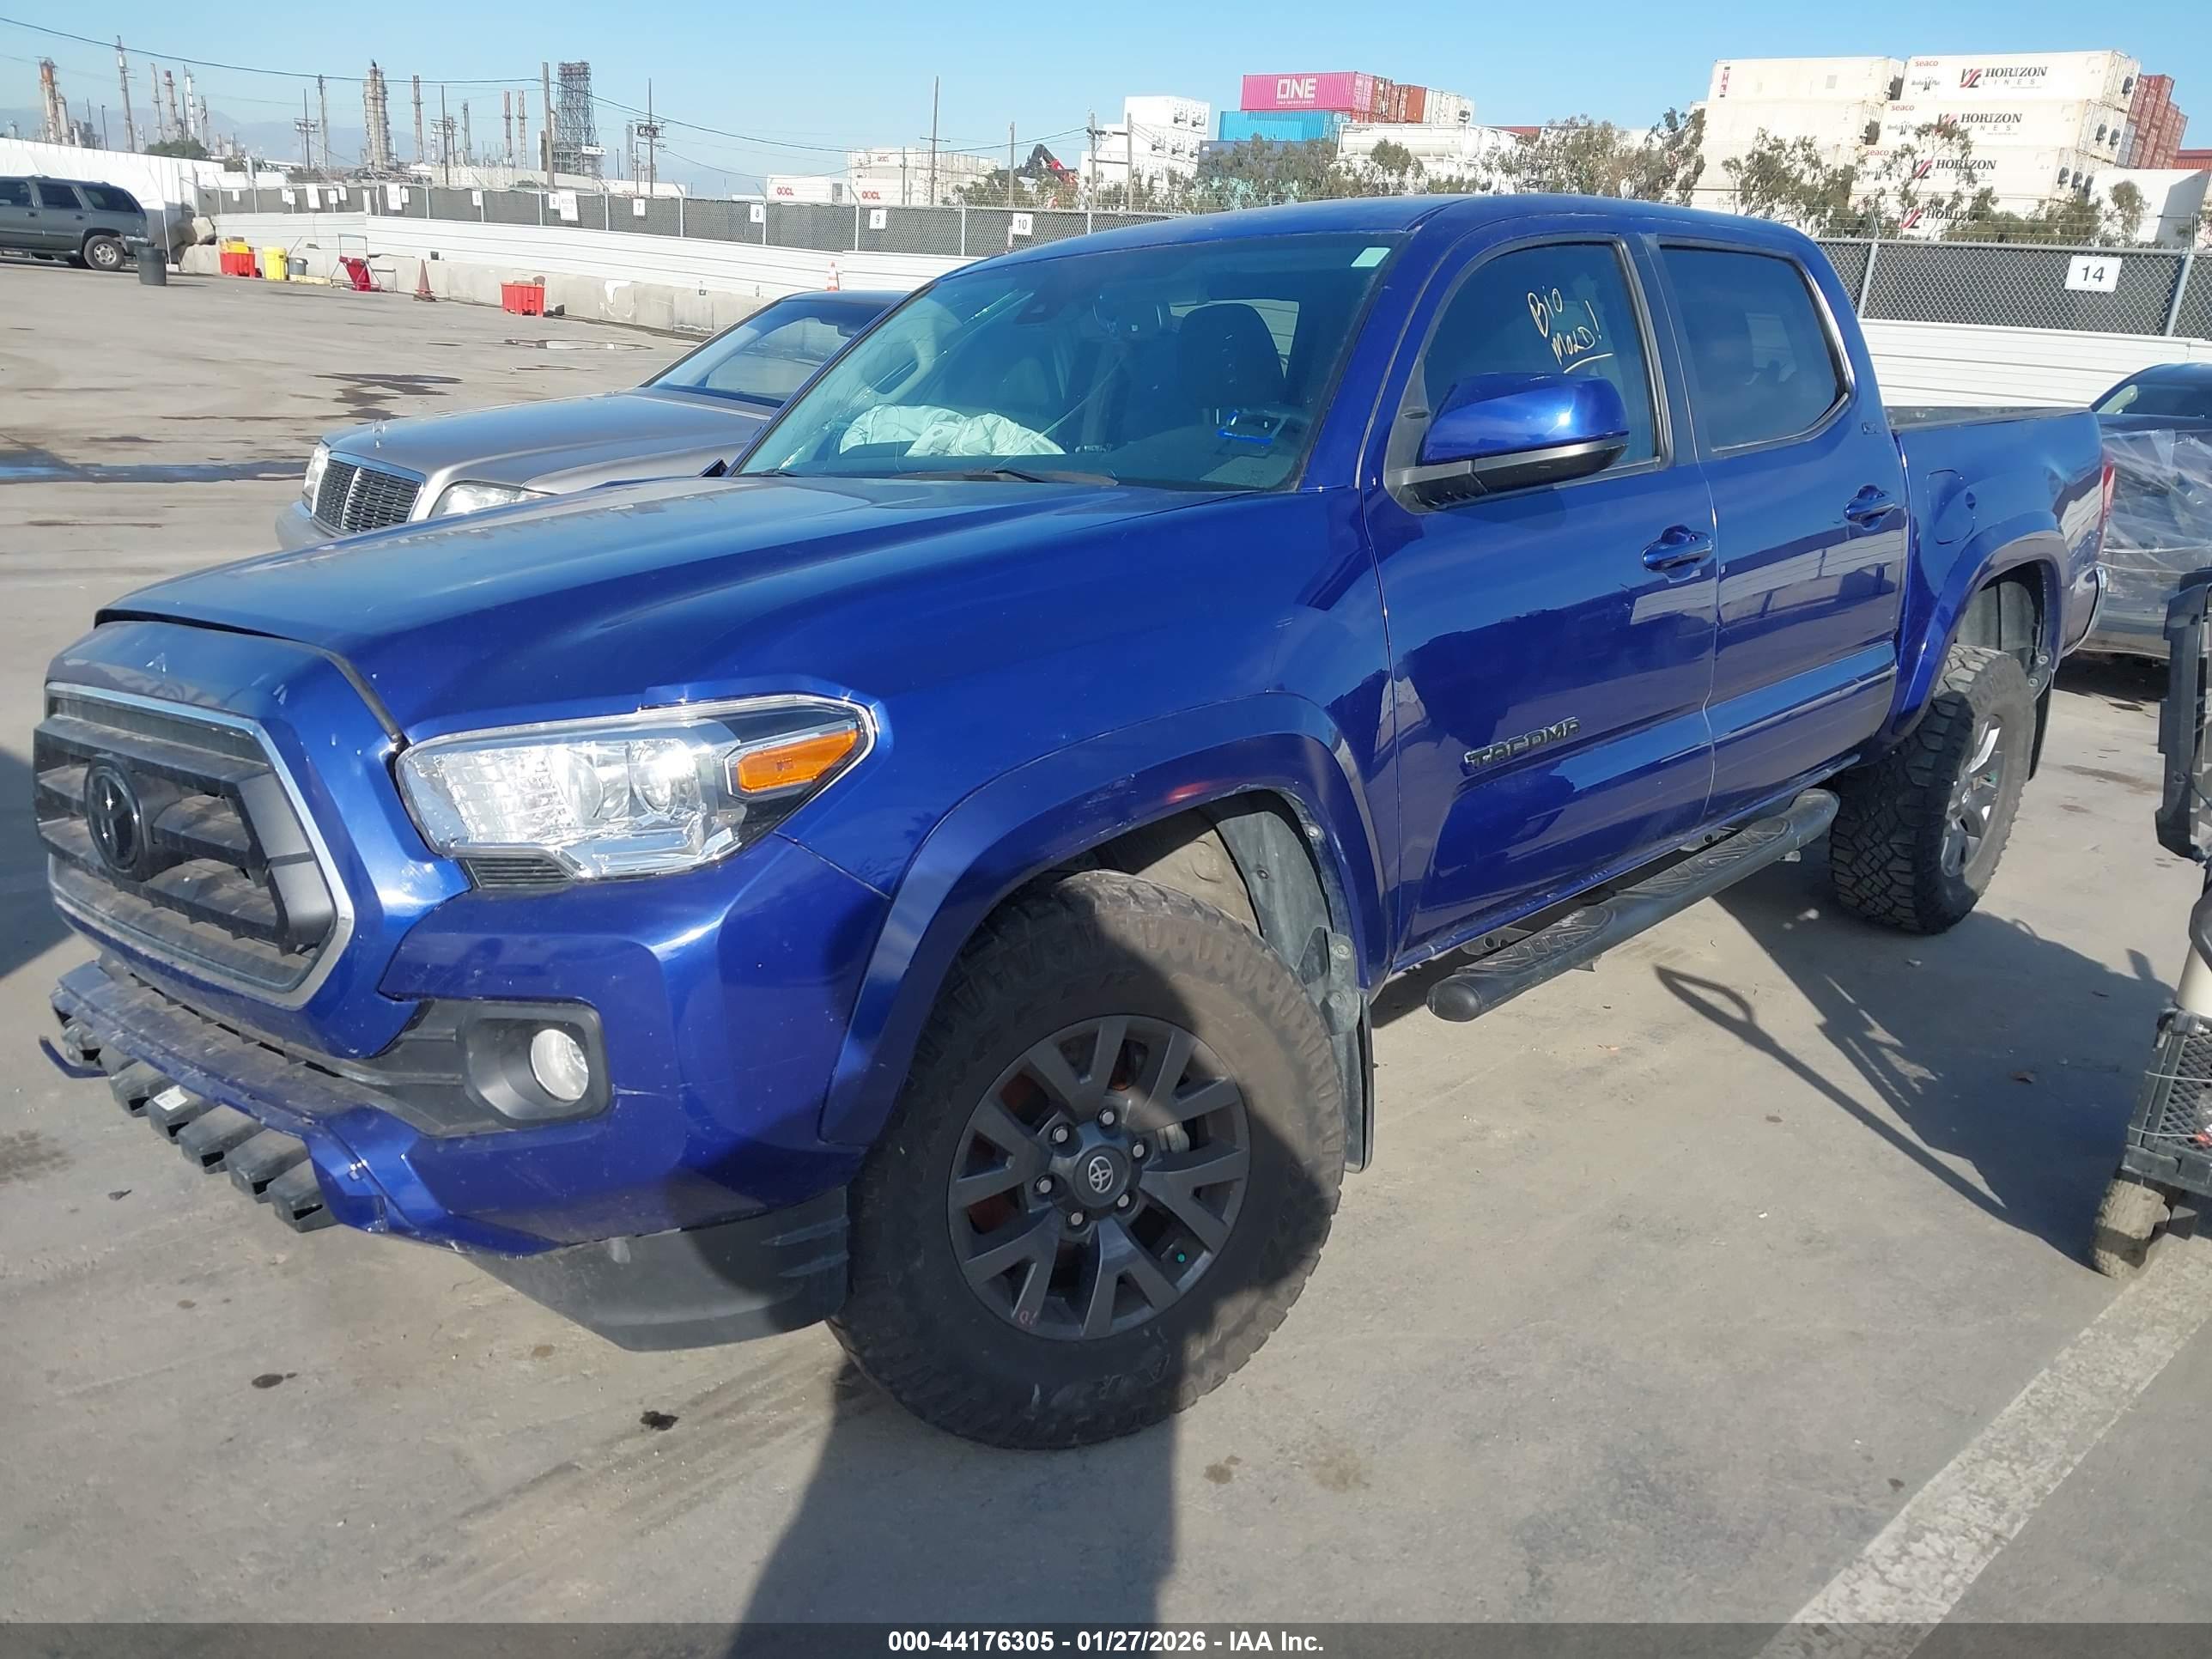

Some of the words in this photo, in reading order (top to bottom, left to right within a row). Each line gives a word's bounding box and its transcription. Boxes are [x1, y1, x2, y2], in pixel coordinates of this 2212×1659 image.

[1984, 66, 2048, 77] HORIZON
[1276, 78, 1316, 99] ONE
[1960, 112, 2022, 124] HORIZON
[1936, 159, 1997, 170] HORIZON
[861, 190, 881, 200] OOCL
[875, 214, 881, 224] 9
[1018, 219, 1028, 230] 10
[2081, 264, 2105, 283] 14
